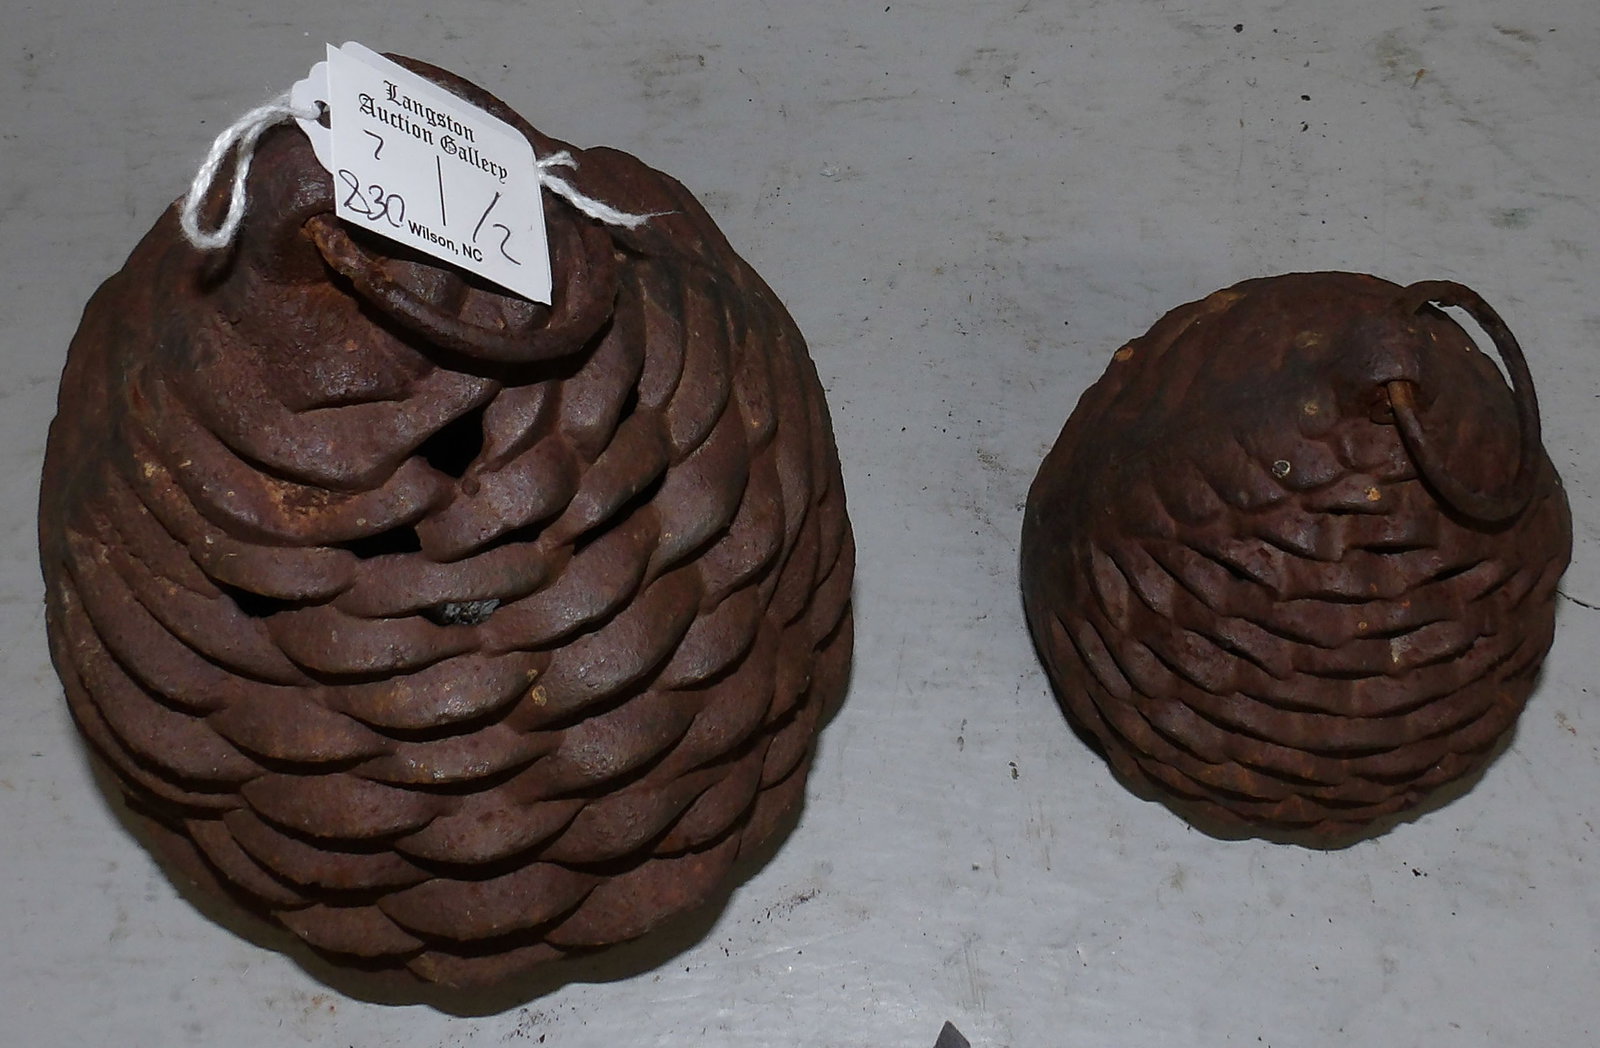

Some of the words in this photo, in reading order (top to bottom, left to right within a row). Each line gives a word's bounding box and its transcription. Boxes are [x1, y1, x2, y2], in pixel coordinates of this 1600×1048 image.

[358, 93, 435, 145] Auction
[440, 135, 508, 184] Gallery
[384, 80, 475, 142] Langston
[338, 169, 405, 227] 830
[408, 220, 459, 254] Wilson,
[462, 243, 483, 262] NC
